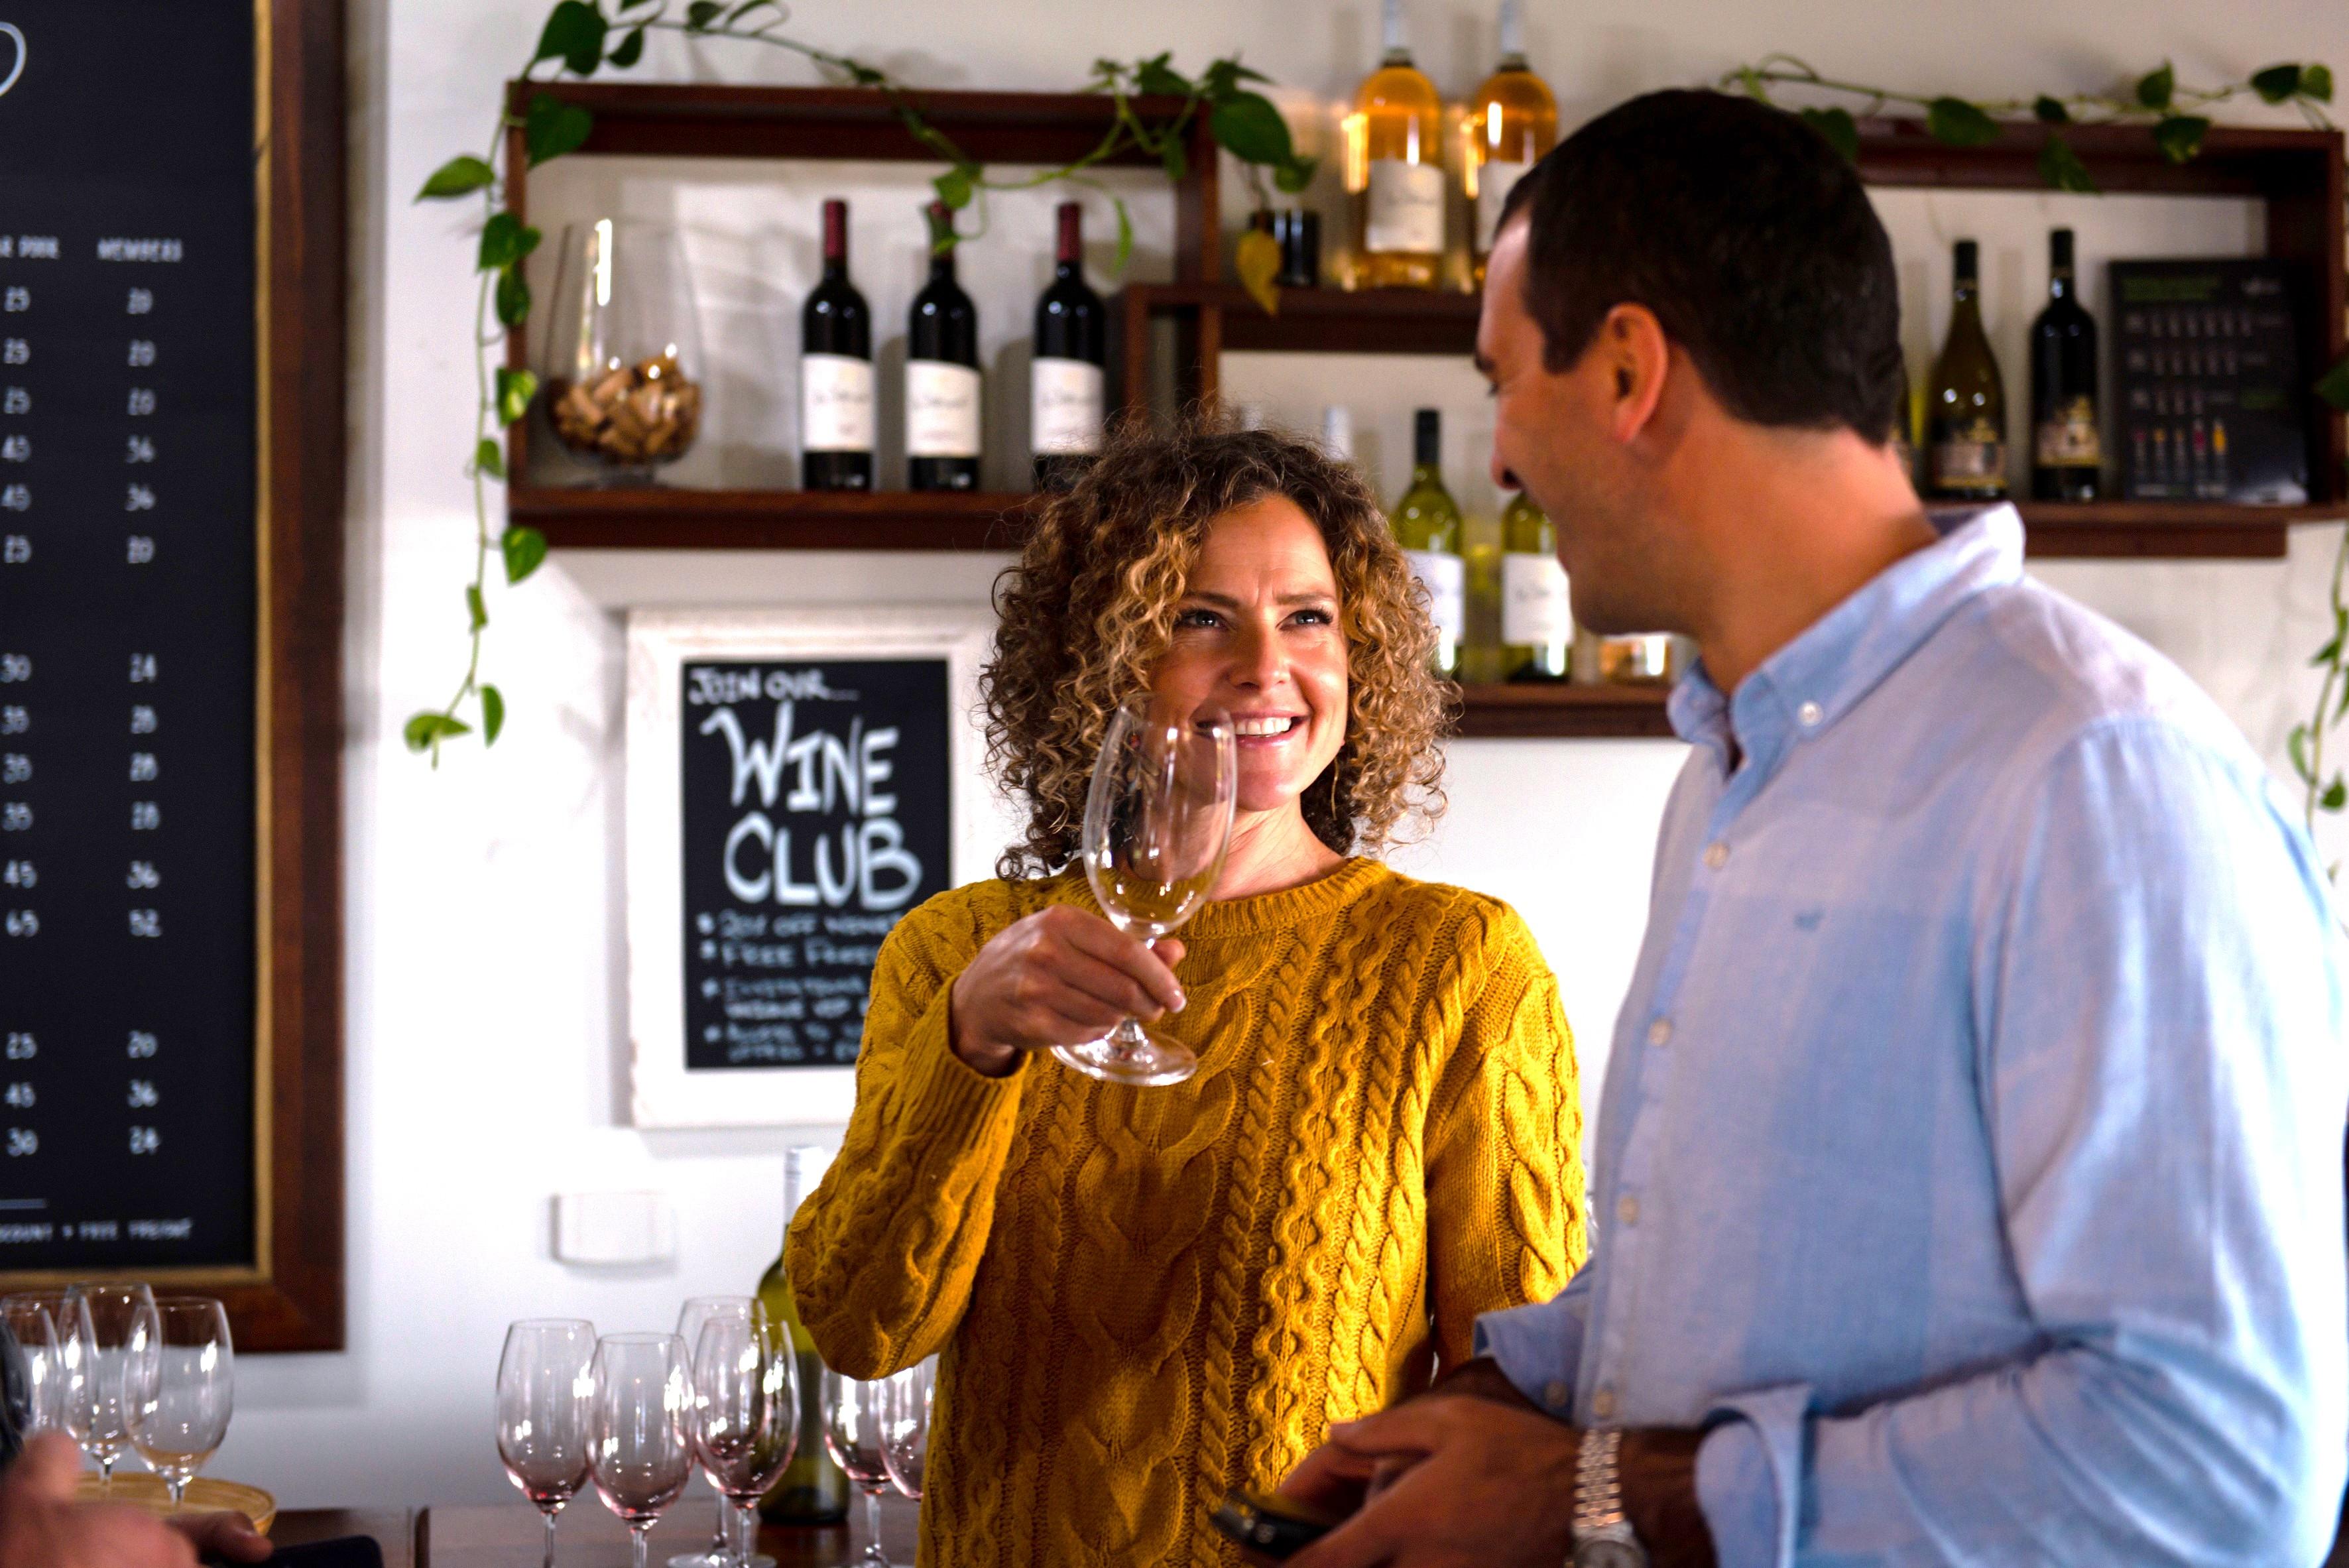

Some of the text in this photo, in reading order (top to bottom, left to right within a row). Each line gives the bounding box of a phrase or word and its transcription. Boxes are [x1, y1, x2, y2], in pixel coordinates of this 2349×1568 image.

[1, 653, 32, 683] 30
[688, 668, 761, 705] JOIN
[699, 699, 899, 816] WINE
[5, 860, 160, 889] 45 36
[724, 810, 923, 911] CLUB
[6, 909, 162, 937] 65 52
[7, 1030, 158, 1059] 25 20
[5, 1079, 158, 1108] 45 36
[7, 1126, 159, 1156] 30 24
